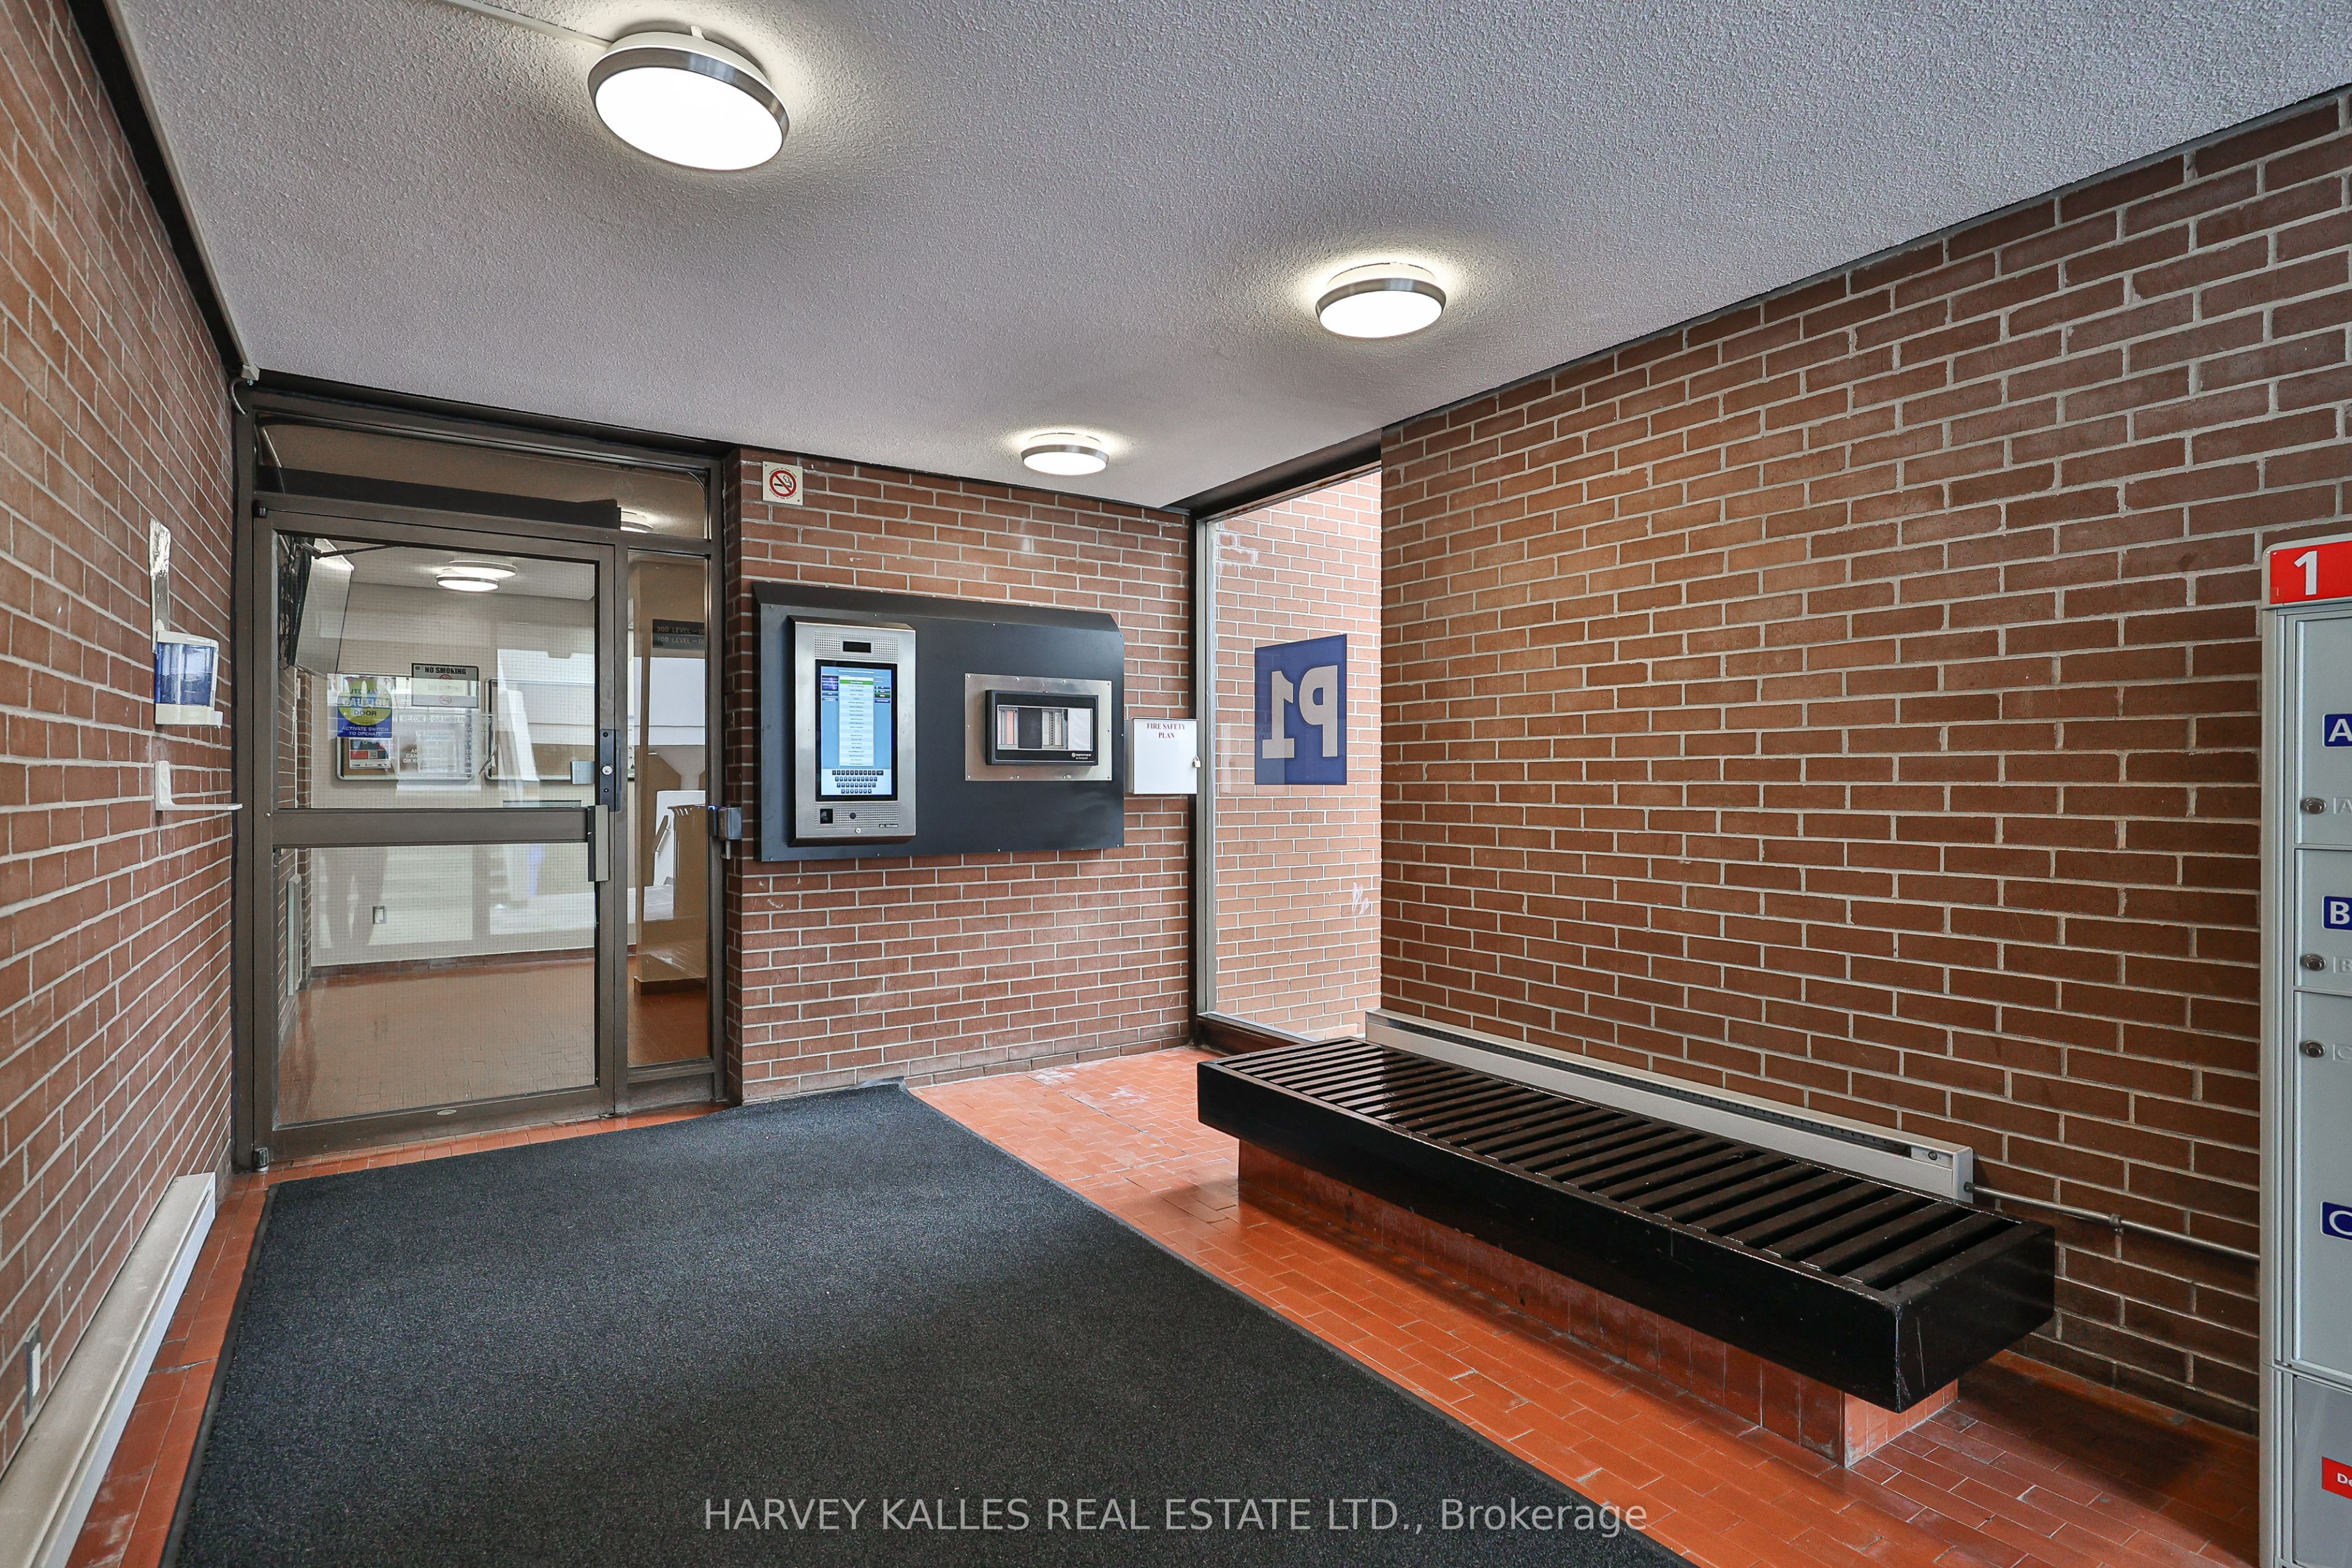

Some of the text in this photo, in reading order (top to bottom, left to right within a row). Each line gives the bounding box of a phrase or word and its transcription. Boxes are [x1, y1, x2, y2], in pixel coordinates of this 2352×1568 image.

[2294, 550, 2318, 596] 1
[2328, 718, 2352, 742] A
[2330, 900, 2350, 925] B
